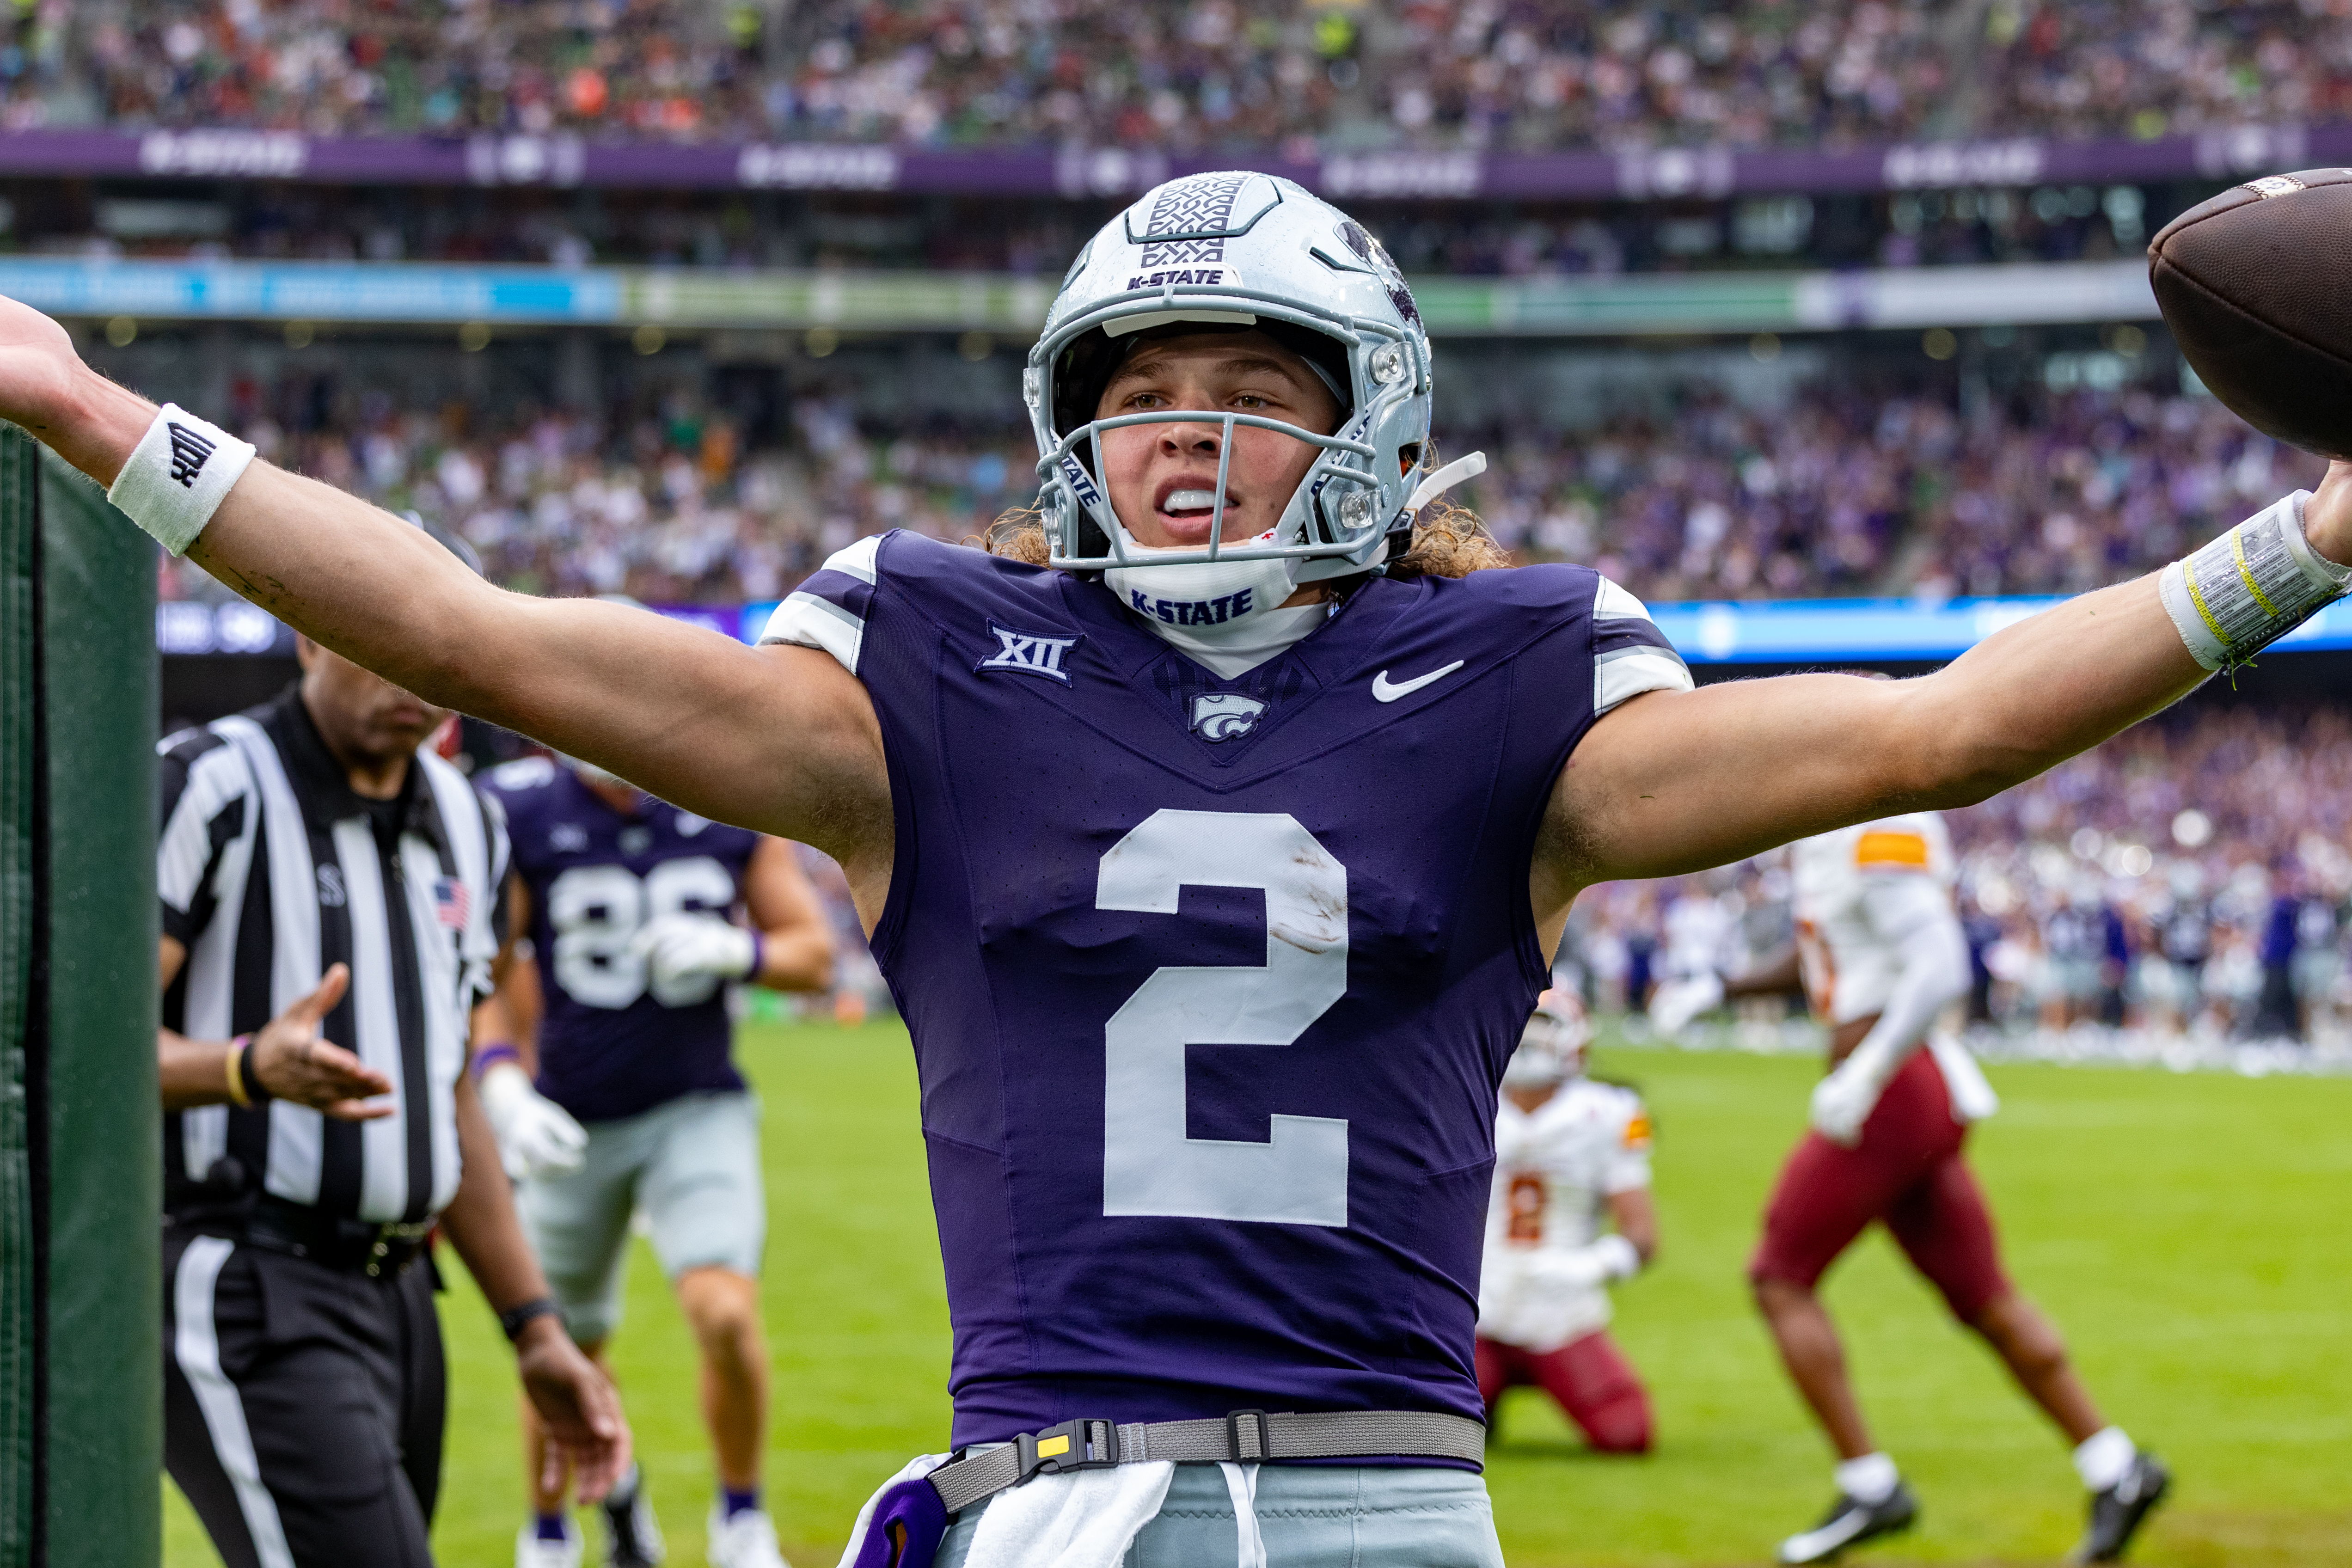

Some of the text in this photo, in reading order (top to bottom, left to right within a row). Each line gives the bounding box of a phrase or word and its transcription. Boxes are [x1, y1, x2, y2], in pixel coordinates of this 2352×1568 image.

[1127, 270, 1223, 290] K-STATE
[2259, 562, 2269, 570] STAY
[2266, 564, 2278, 573] STONE
[2269, 579, 2280, 588] IRISH
[2212, 591, 2222, 600] STAY
[2221, 593, 2232, 602] STONE
[1131, 588, 1253, 625] K-STATE
[2223, 608, 2234, 616] IRISH
[983, 626, 1076, 680] XII
[1096, 808, 1348, 1227] 2
